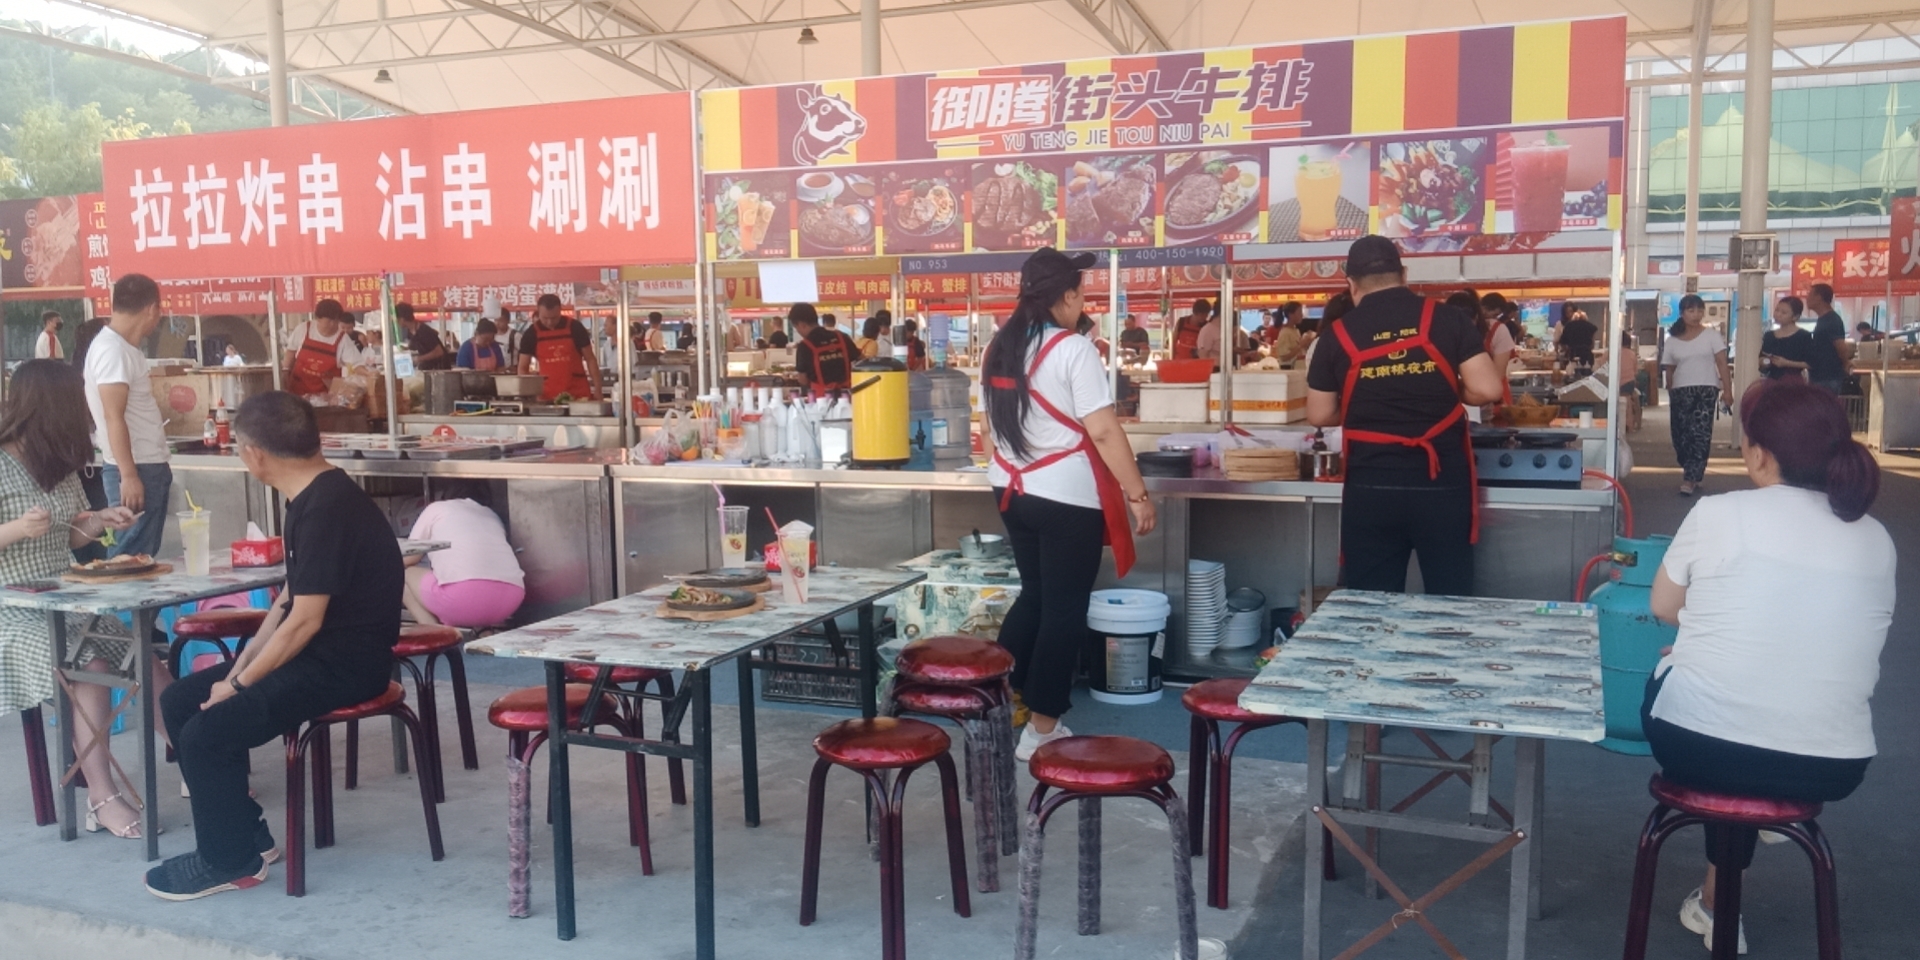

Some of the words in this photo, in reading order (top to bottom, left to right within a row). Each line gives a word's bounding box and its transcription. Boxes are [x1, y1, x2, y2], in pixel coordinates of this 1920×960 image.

[931, 58, 1313, 132] 御腾街头牛排
[1003, 133, 1025, 150] YU
[1031, 130, 1078, 149] TENG
[1085, 129, 1109, 147] JIE
[1114, 126, 1154, 143] TOU
[1159, 123, 1193, 142] NIU
[1200, 122, 1230, 139] PAI
[130, 153, 343, 252] 拉拉炸串
[376, 143, 491, 239] 沾串
[528, 133, 659, 233] 涮涮
[928, 258, 948, 270] 953
[1098, 267, 1131, 286] 牛面
